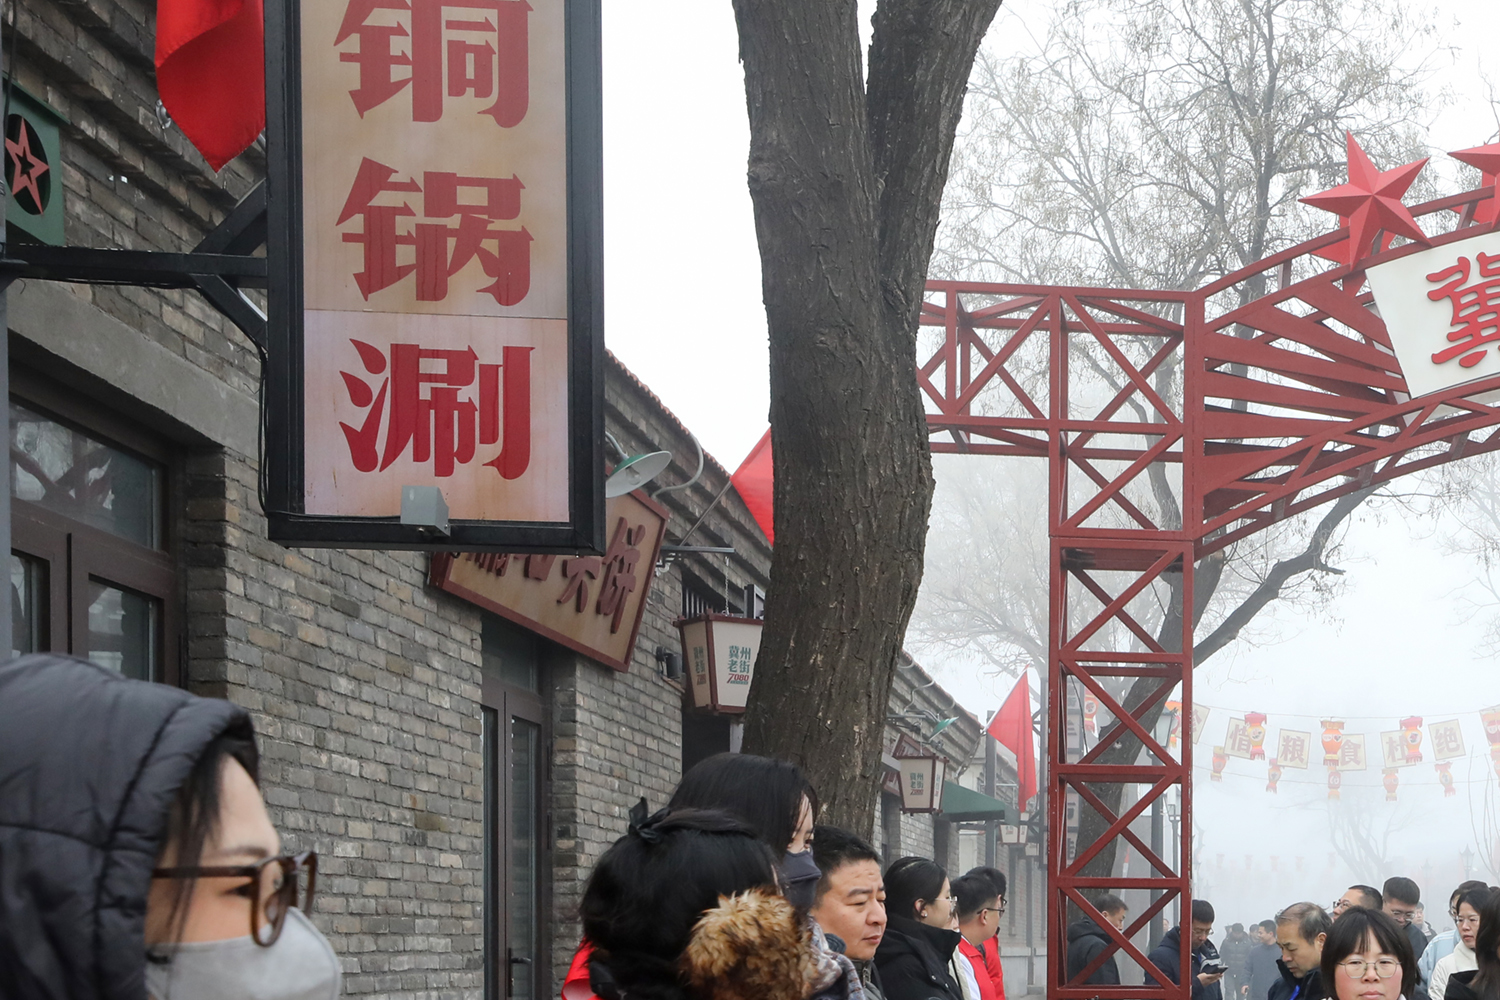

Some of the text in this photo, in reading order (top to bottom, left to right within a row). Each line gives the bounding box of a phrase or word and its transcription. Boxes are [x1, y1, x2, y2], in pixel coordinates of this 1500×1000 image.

[334, 0, 535, 478] 铜锅涮
[729, 645, 751, 660] 冀州
[728, 659, 750, 673] 老街
[727, 673, 749, 684] 7080
